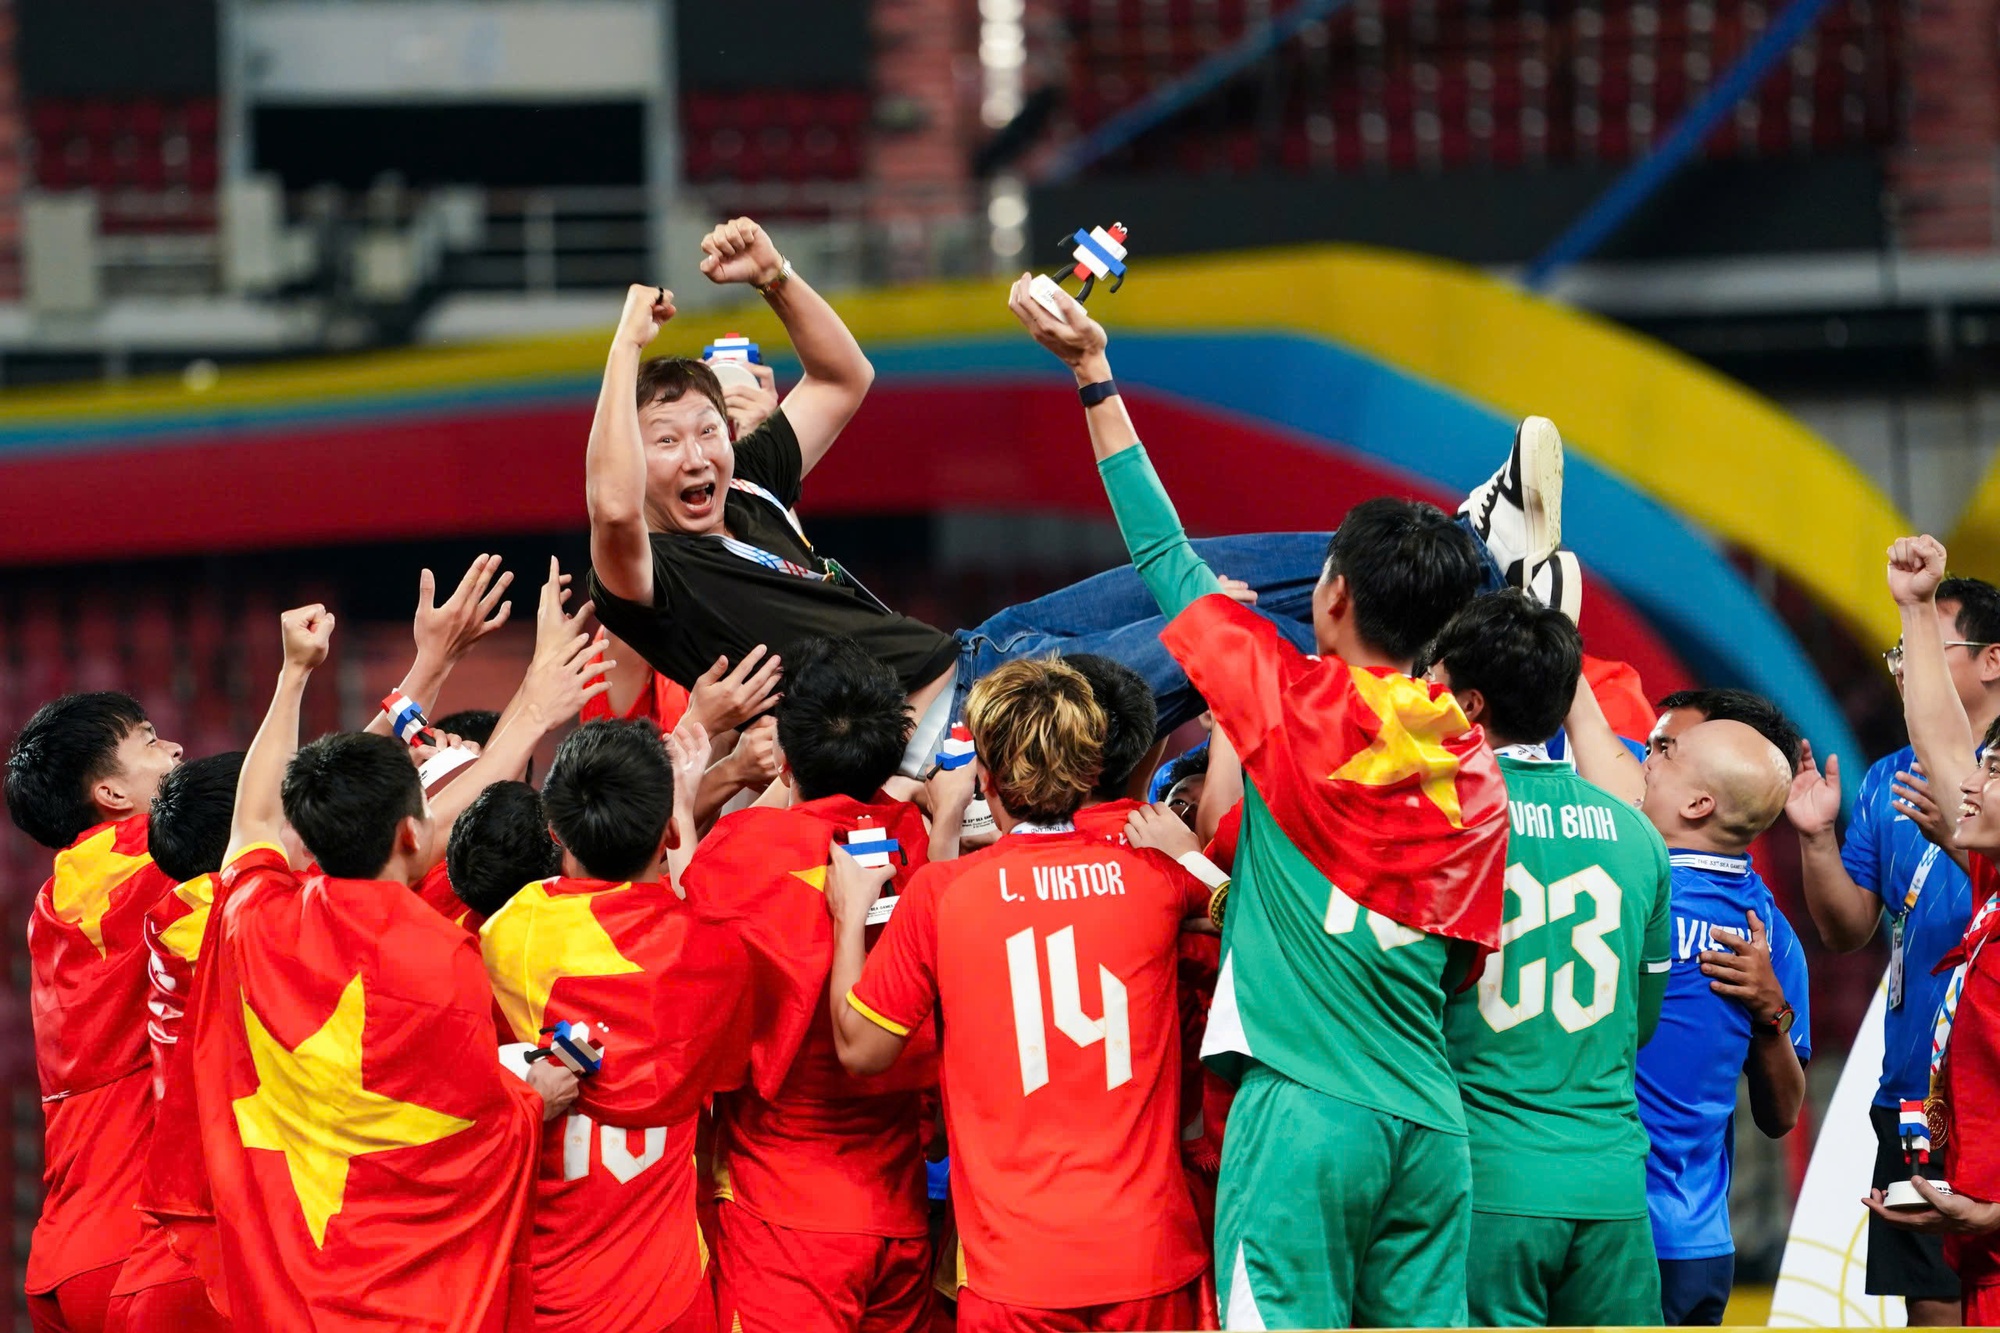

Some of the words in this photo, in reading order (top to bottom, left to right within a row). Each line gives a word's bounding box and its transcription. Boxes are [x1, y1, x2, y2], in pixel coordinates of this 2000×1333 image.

[1508, 800, 1555, 839] VAN
[1560, 804, 1618, 842] BINH
[998, 868, 1026, 902] L.
[1032, 860, 1126, 901] VIKTOR
[1477, 862, 1623, 1034] 23
[1005, 924, 1133, 1098] 14
